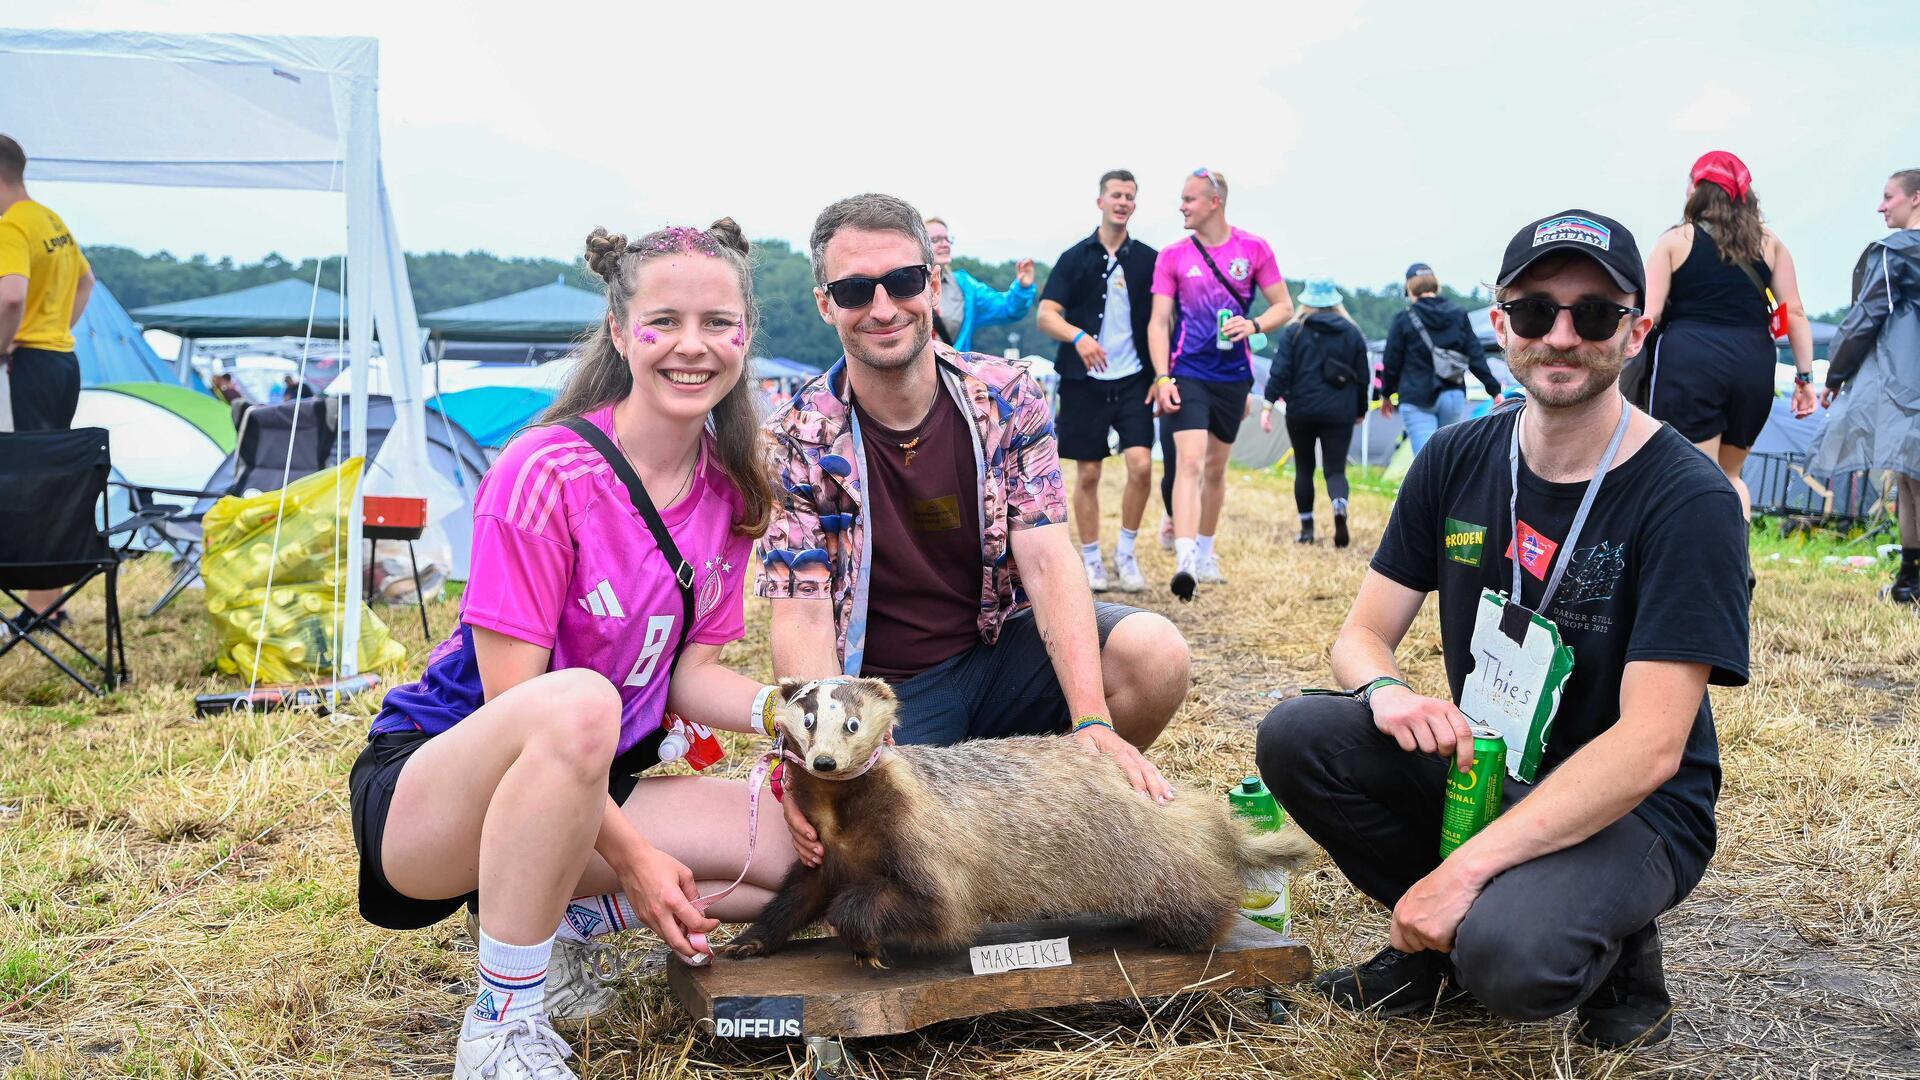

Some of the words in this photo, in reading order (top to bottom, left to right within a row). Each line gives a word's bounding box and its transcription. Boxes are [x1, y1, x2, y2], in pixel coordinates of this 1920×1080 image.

[1445, 531, 1483, 548] #RODEN
[1553, 607, 1588, 622] DARKER
[1591, 614, 1613, 625] STILL
[1555, 617, 1590, 630] EUROPE
[1592, 624, 1608, 633] 2022
[622, 615, 675, 687] 8
[1482, 648, 1532, 705] Thies
[980, 942, 1066, 969] MAREIKE
